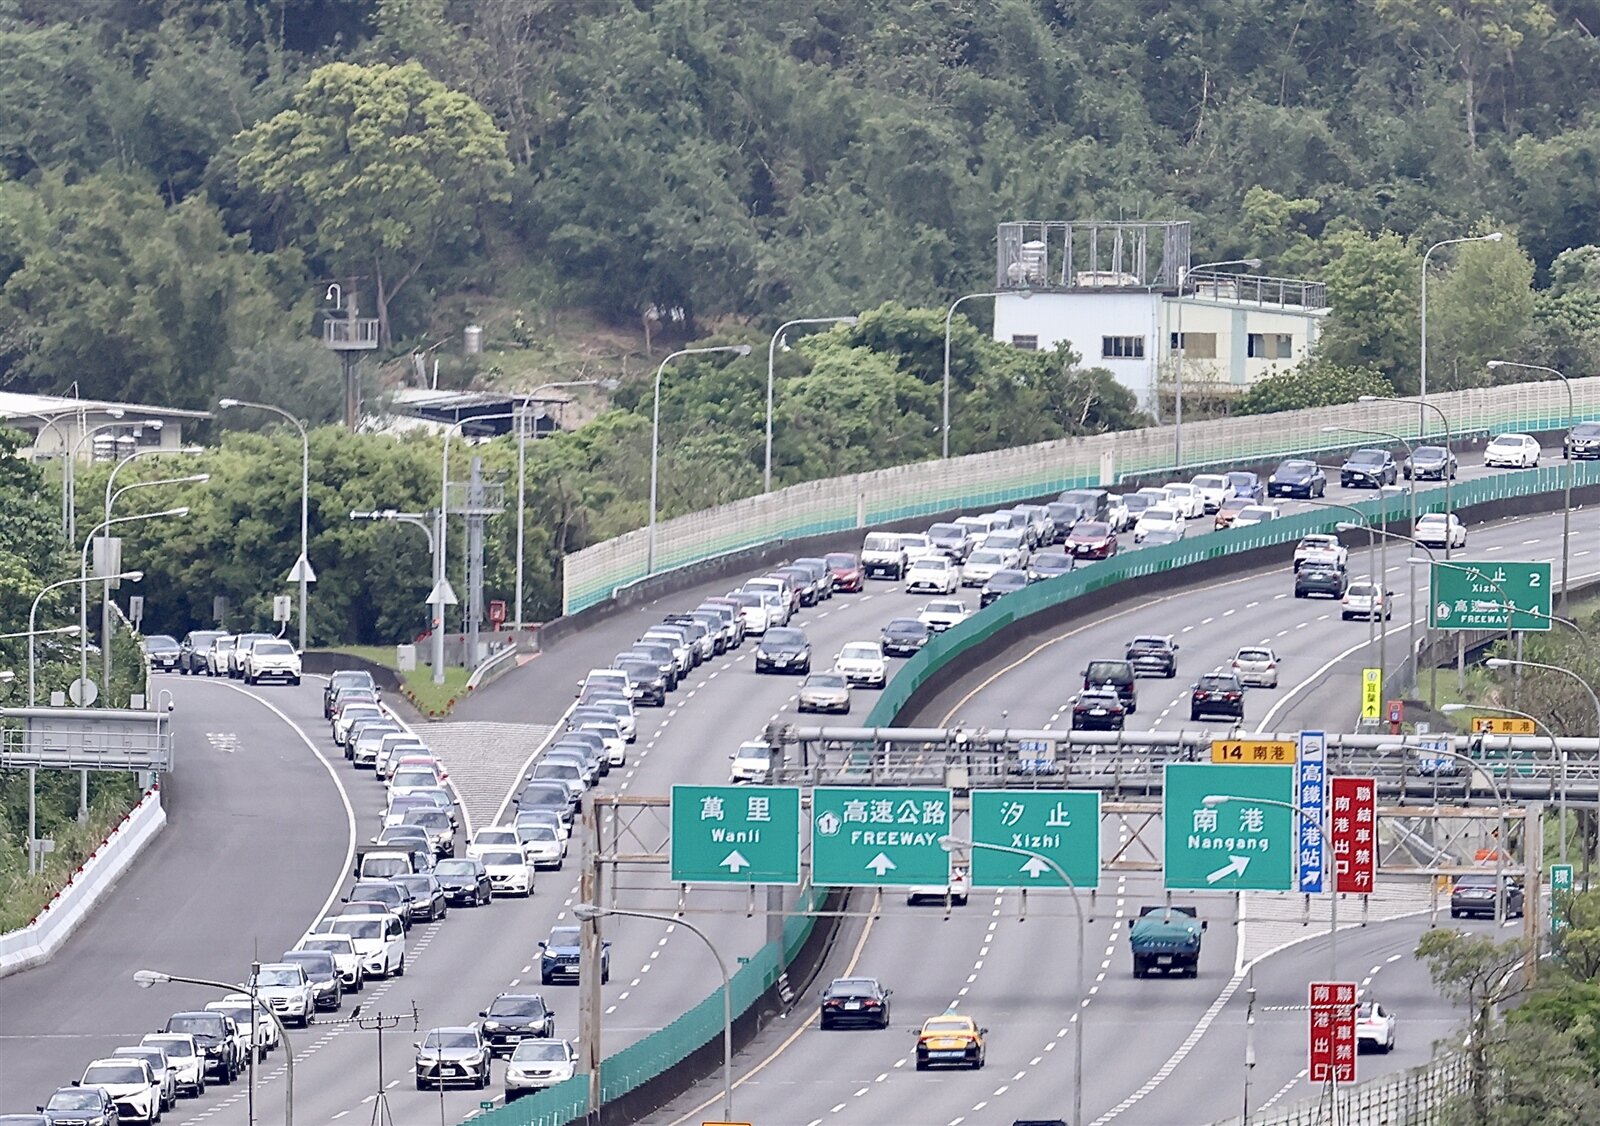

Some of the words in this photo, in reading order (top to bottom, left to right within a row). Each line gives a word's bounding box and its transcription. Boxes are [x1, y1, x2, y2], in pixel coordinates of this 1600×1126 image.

[1465, 566, 1507, 582] 汐止
[1529, 573, 1541, 588] 2
[1460, 614, 1509, 624] FREEWAY
[1502, 720, 1531, 732] 南港
[1222, 745, 1243, 760] 14
[1253, 745, 1285, 761] 南港
[700, 795, 771, 822] 萬里
[842, 799, 946, 826] 高速公路
[1000, 801, 1072, 827] 汐止
[1193, 807, 1264, 834] 南港
[1301, 763, 1322, 868] 高鐵南港站
[711, 828, 760, 843] Wanli
[851, 830, 937, 847] FREEWAY
[1011, 833, 1061, 848] Xizhi
[1187, 834, 1270, 852] Nangang
[1334, 796, 1350, 875] 南港出口
[1355, 785, 1372, 887] 聯結車禁行
[1313, 985, 1330, 1079] 南港出口
